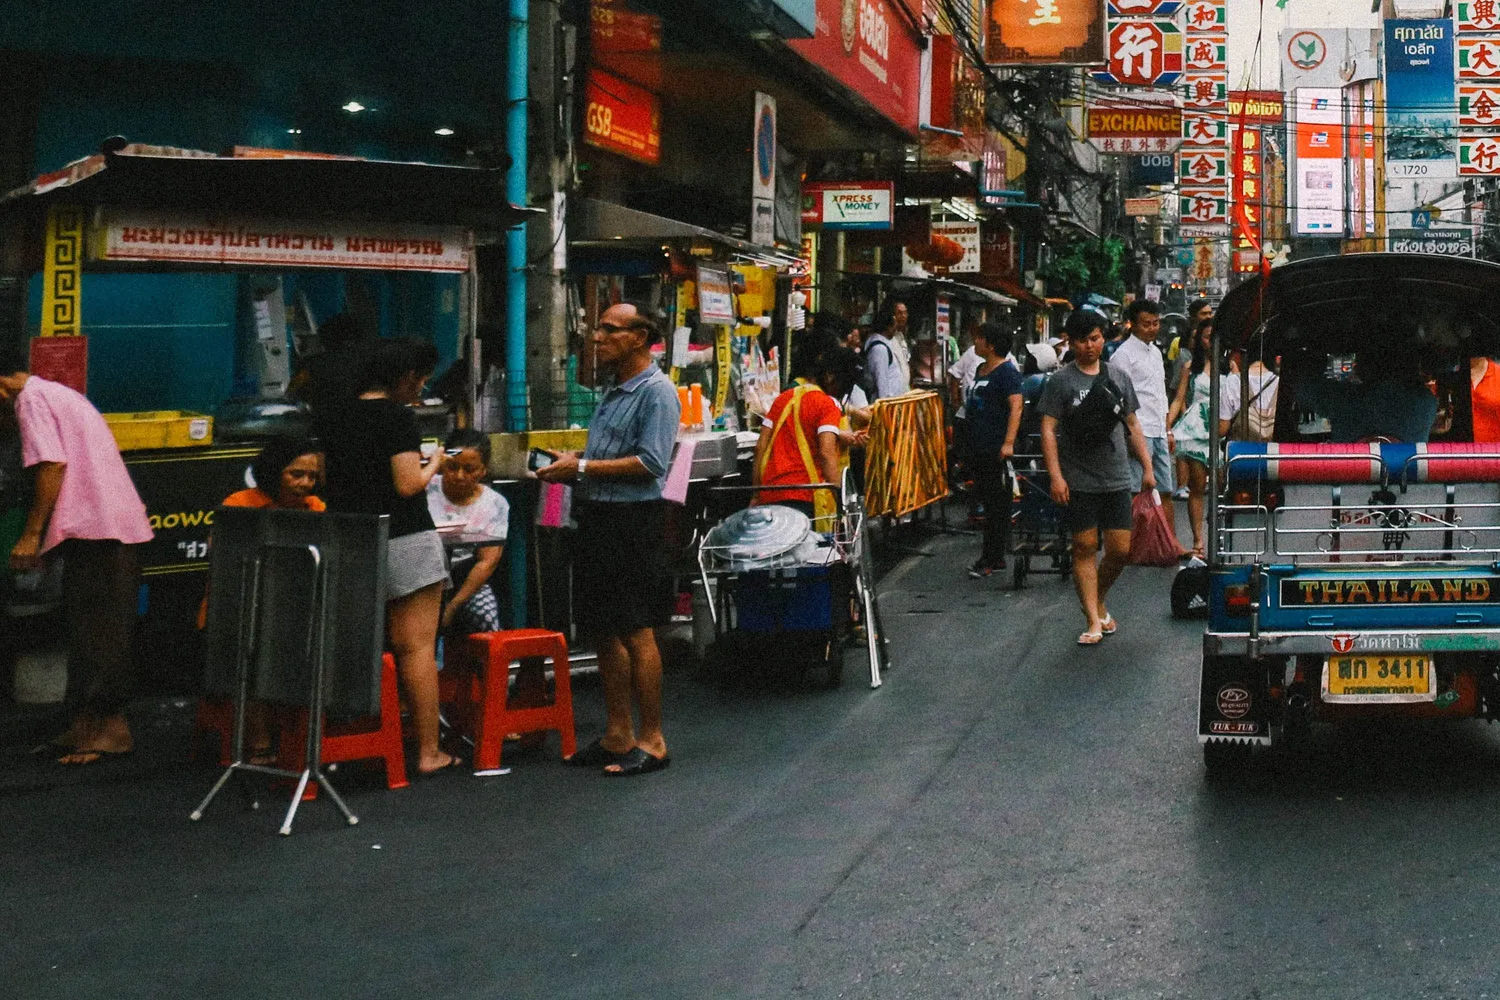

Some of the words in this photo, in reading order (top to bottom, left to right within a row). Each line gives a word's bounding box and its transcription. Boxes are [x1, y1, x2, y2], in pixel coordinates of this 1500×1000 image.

[1394, 24, 1444, 42] ศุภาลัย
[1404, 43, 1435, 55] เอลีท
[587, 102, 612, 137] GSB
[1089, 112, 1180, 132] EXCHANGE
[1141, 155, 1171, 167] UOB
[1403, 165, 1427, 175] 1720
[844, 202, 880, 211] MONEY
[1300, 579, 1491, 604] THAILAND
[1378, 659, 1424, 679] 3411
[1213, 723, 1230, 731] TUK
[1237, 723, 1254, 731] TUK
